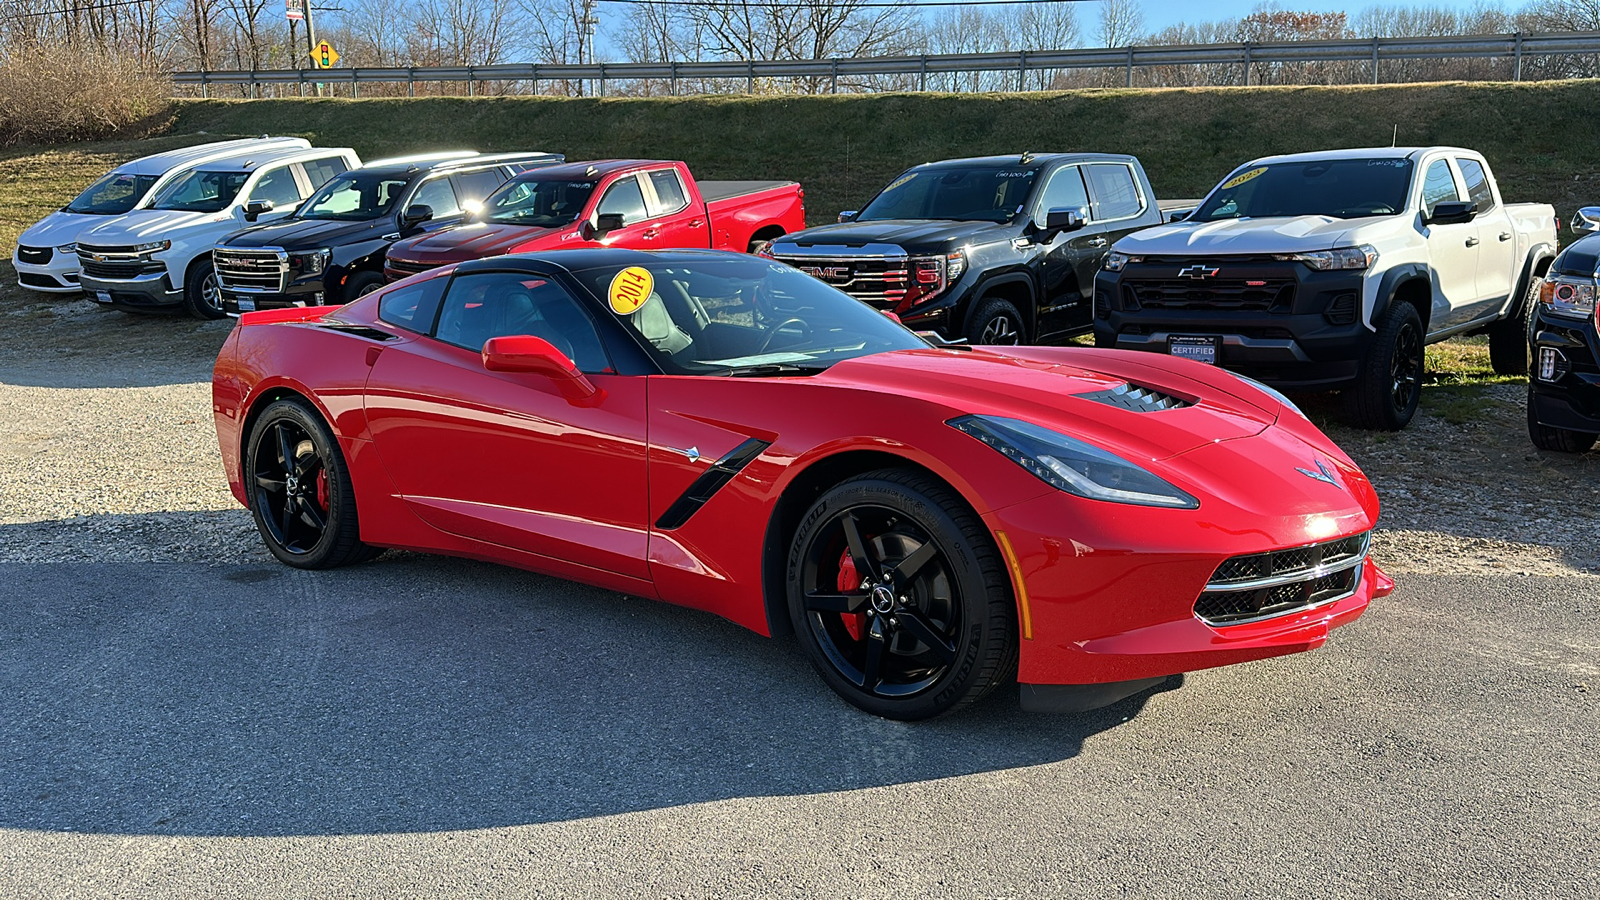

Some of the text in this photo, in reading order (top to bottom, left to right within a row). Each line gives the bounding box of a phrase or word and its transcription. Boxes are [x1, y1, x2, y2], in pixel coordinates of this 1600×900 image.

[1230, 169, 1261, 187] 2023
[799, 266, 849, 279] GMC
[616, 270, 646, 306] 2014
[1171, 346, 1215, 355] CERTIFIED
[330, 471, 339, 519] MICHELIN
[845, 487, 862, 496] SPORT
[876, 487, 899, 496] SEASON
[791, 502, 825, 562] MICHELIN
[936, 644, 977, 704] MICHELIN
